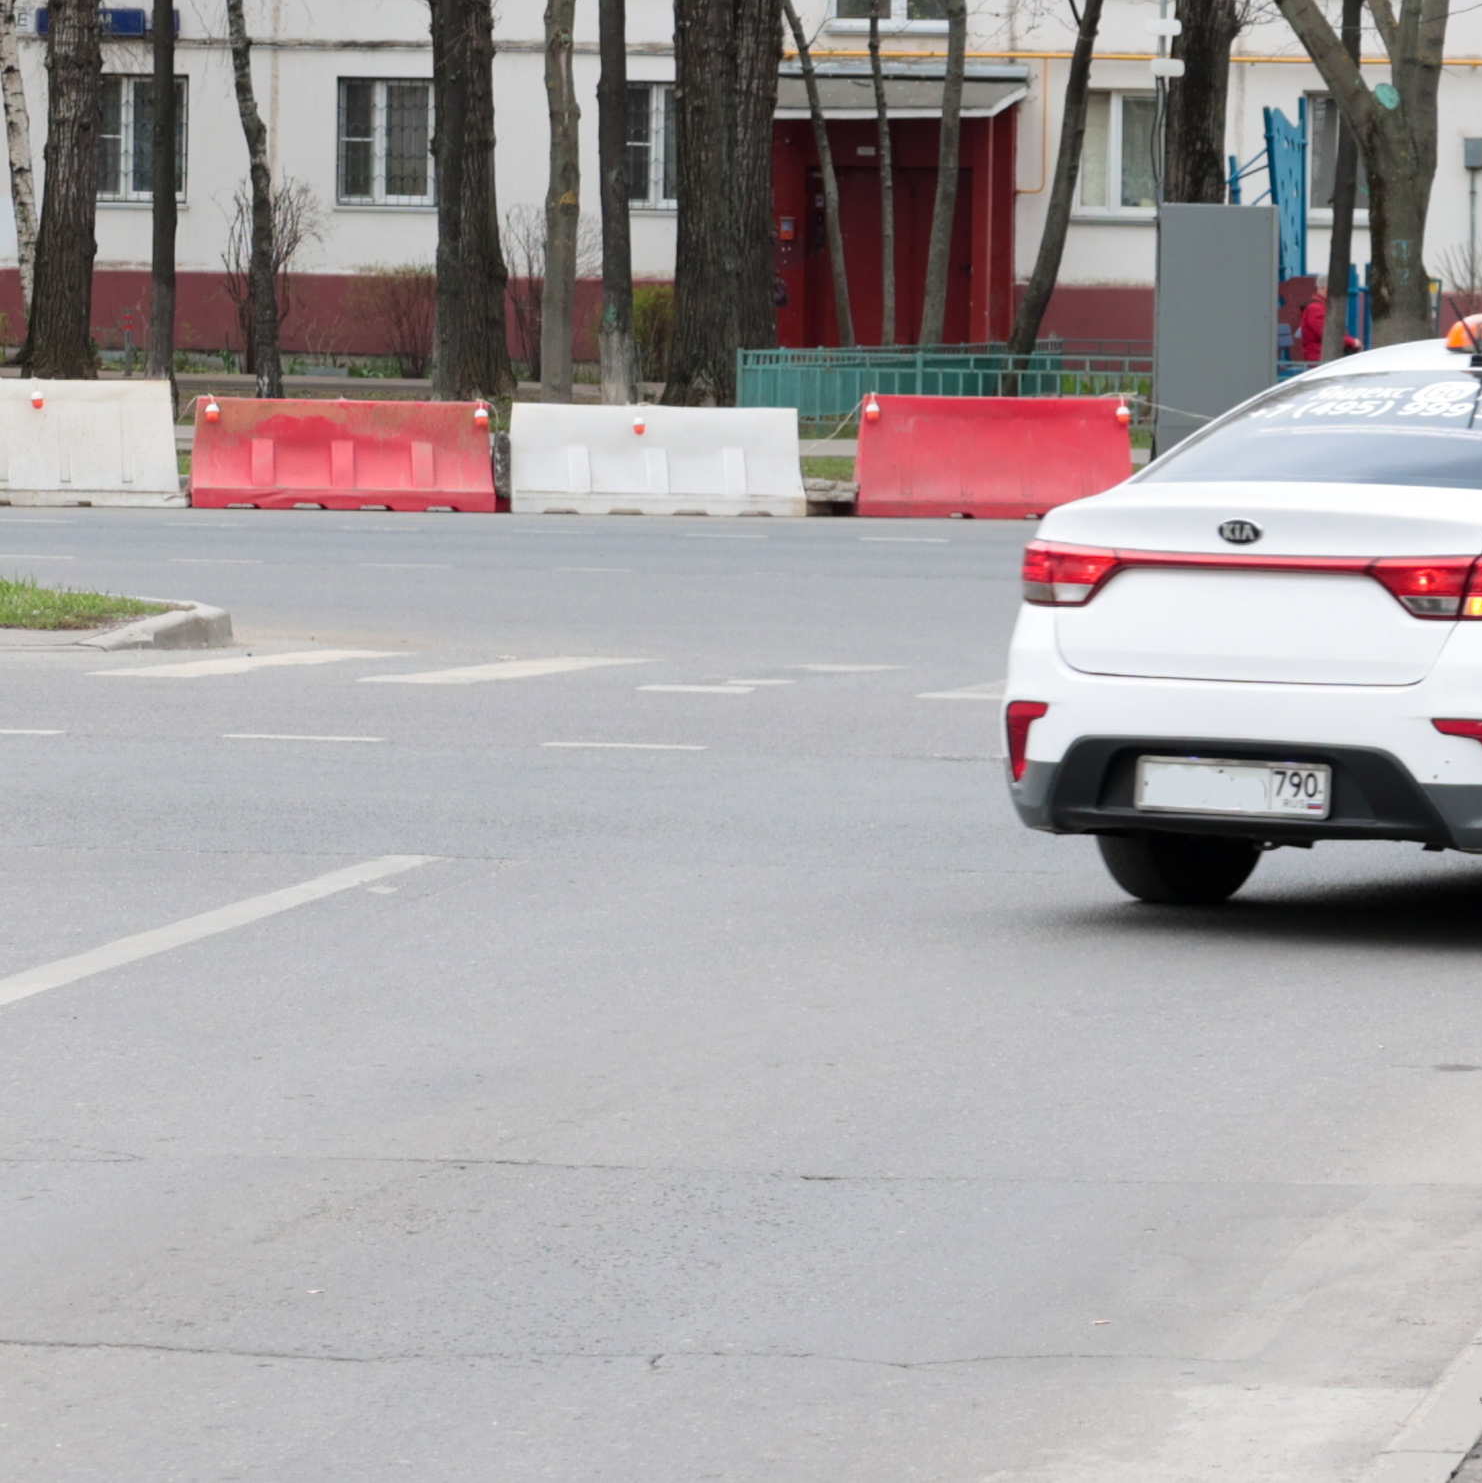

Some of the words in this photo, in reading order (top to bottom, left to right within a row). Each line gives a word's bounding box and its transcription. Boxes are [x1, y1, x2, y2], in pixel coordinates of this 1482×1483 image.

[1309, 385, 1416, 402] Яндекс
[1248, 403, 1296, 418] +7
[1292, 399, 1396, 419] (495)
[1396, 401, 1475, 418] 999
[1221, 523, 1256, 540] KIA
[1273, 770, 1318, 798] 790
